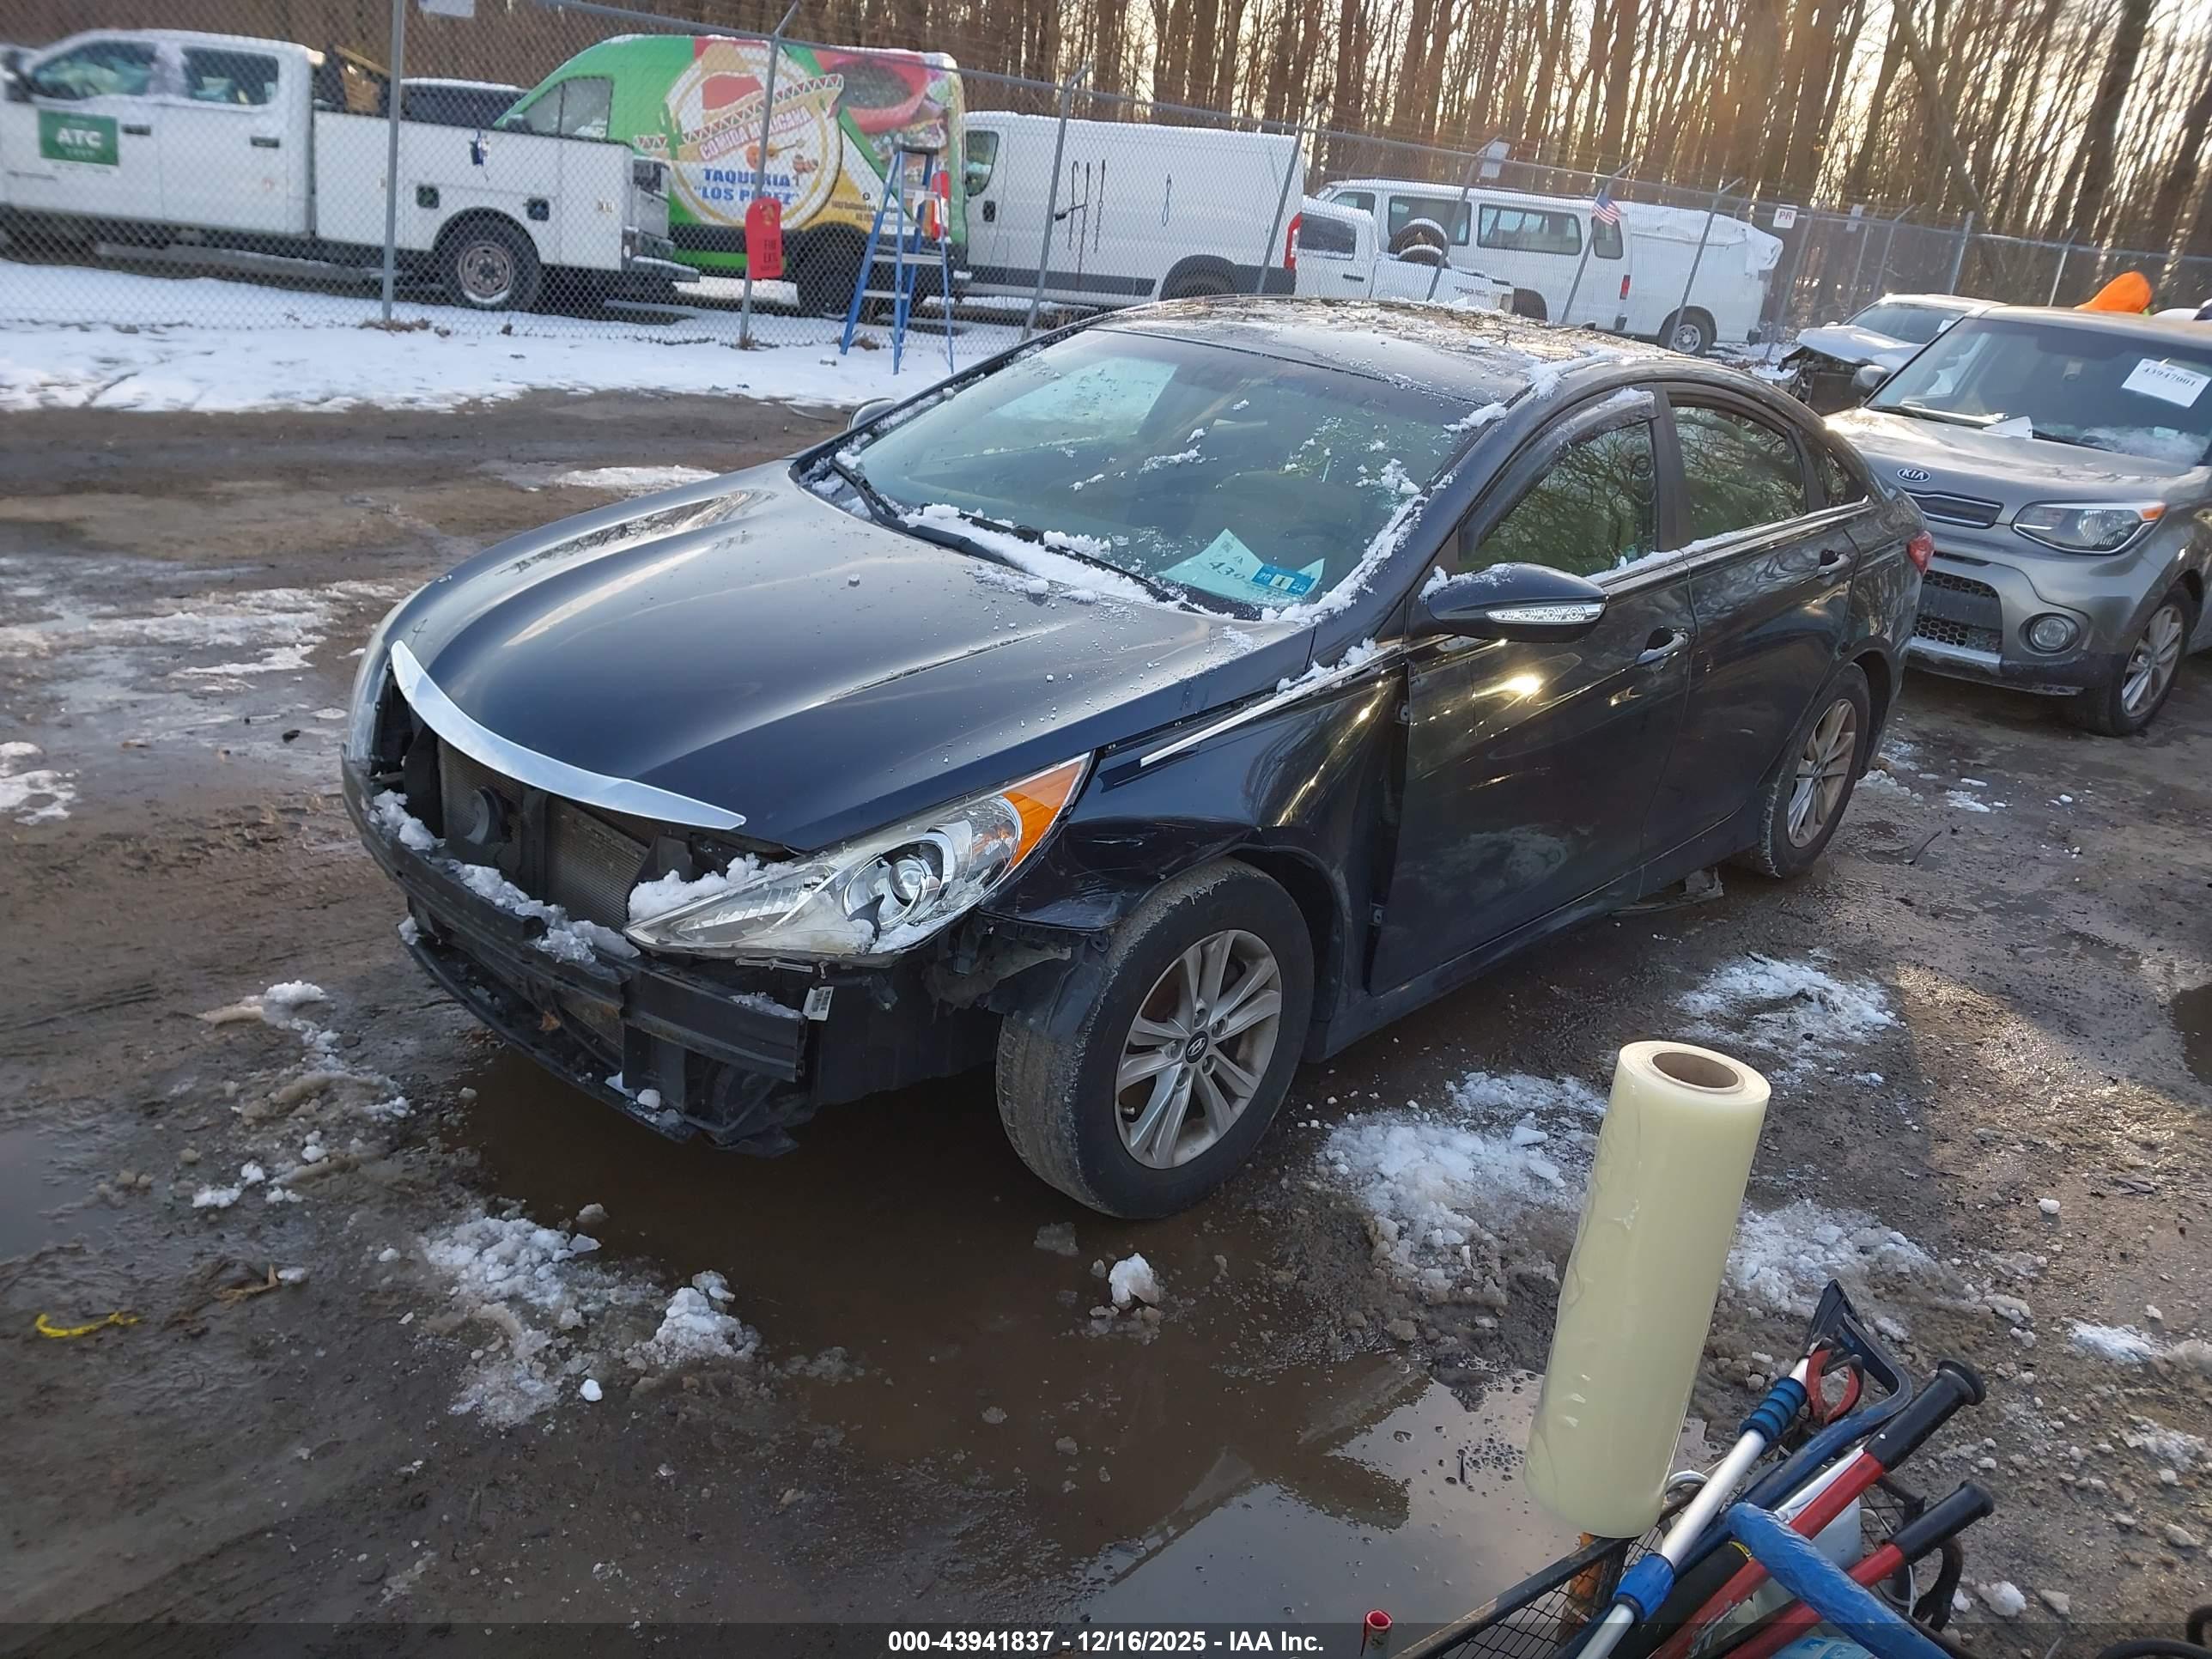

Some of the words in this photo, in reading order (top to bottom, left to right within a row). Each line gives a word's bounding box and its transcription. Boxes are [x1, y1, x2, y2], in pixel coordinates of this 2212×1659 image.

[56, 127, 103, 149] ATC
[699, 126, 750, 161] COMIDA
[1901, 468, 1924, 480] KIA
